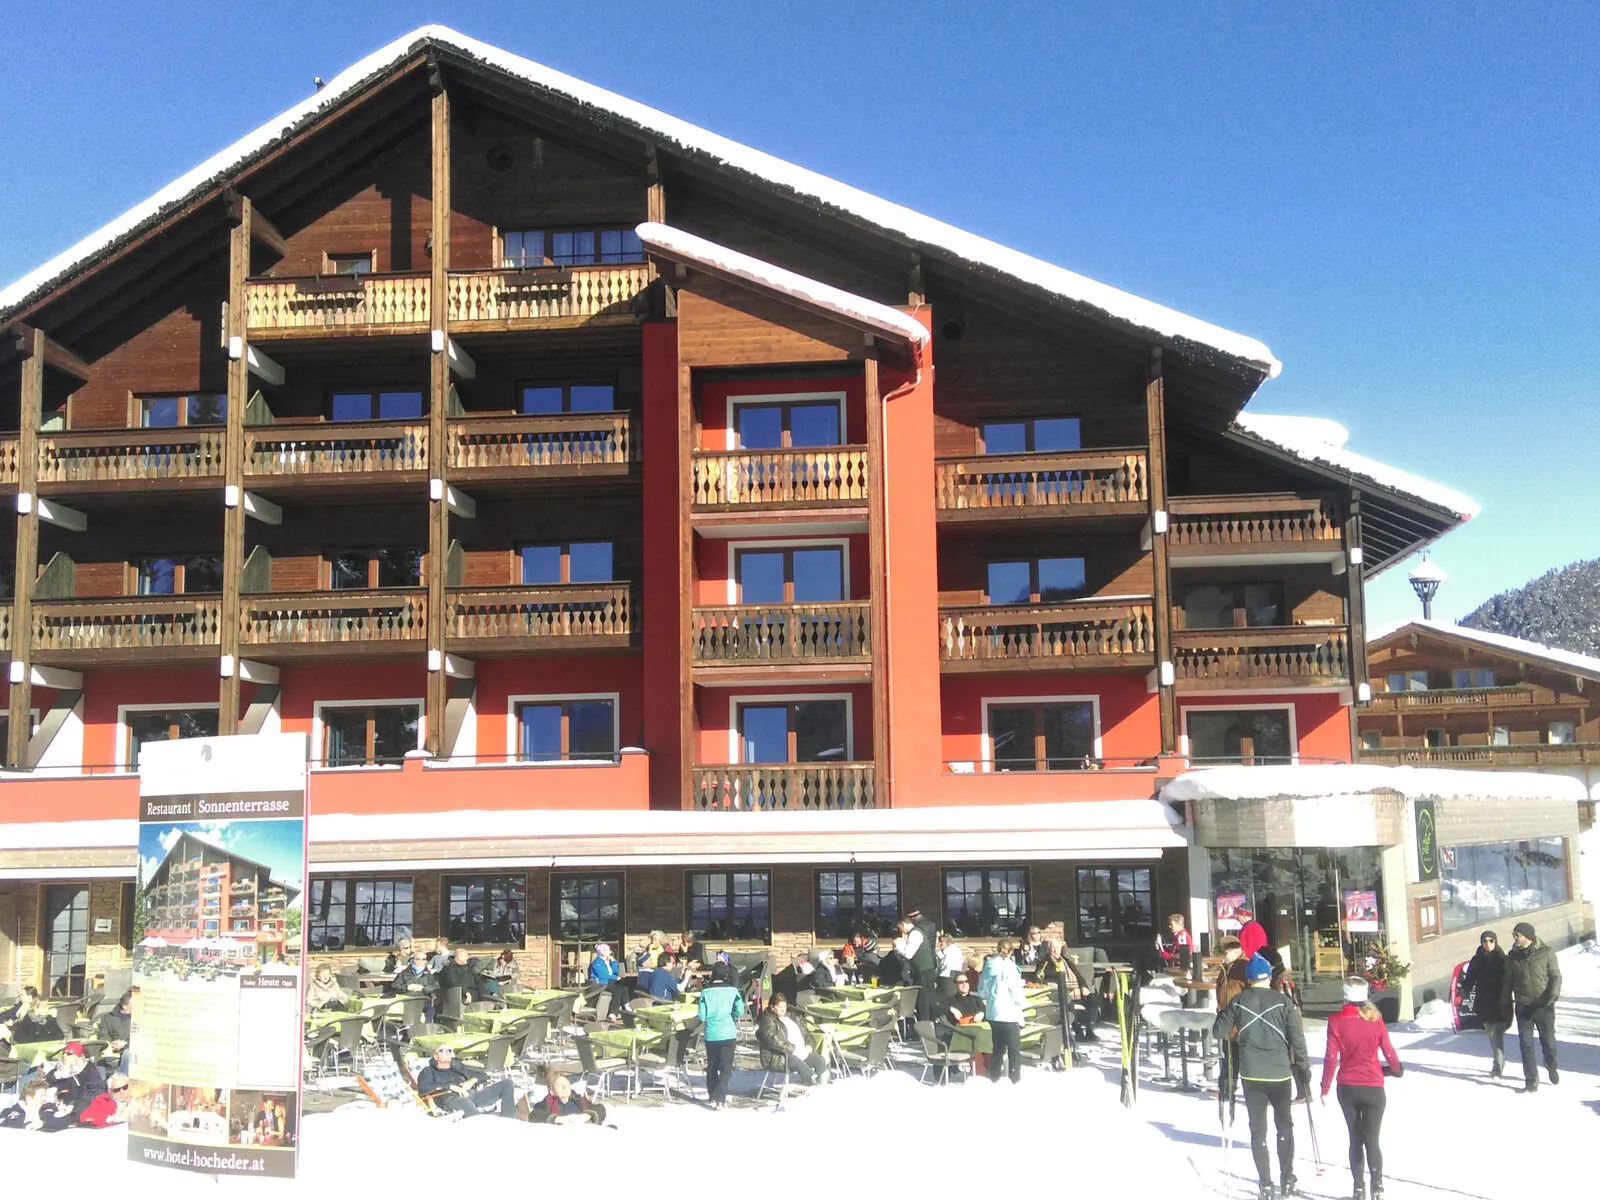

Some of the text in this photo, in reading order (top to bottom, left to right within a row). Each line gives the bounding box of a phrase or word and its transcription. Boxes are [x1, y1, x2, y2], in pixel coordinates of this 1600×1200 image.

[147, 799, 290, 816] Restaurant Sonnenterrasse
[258, 977, 280, 987] Heute
[143, 1147, 265, 1171] www.hotel-hocheder.at
